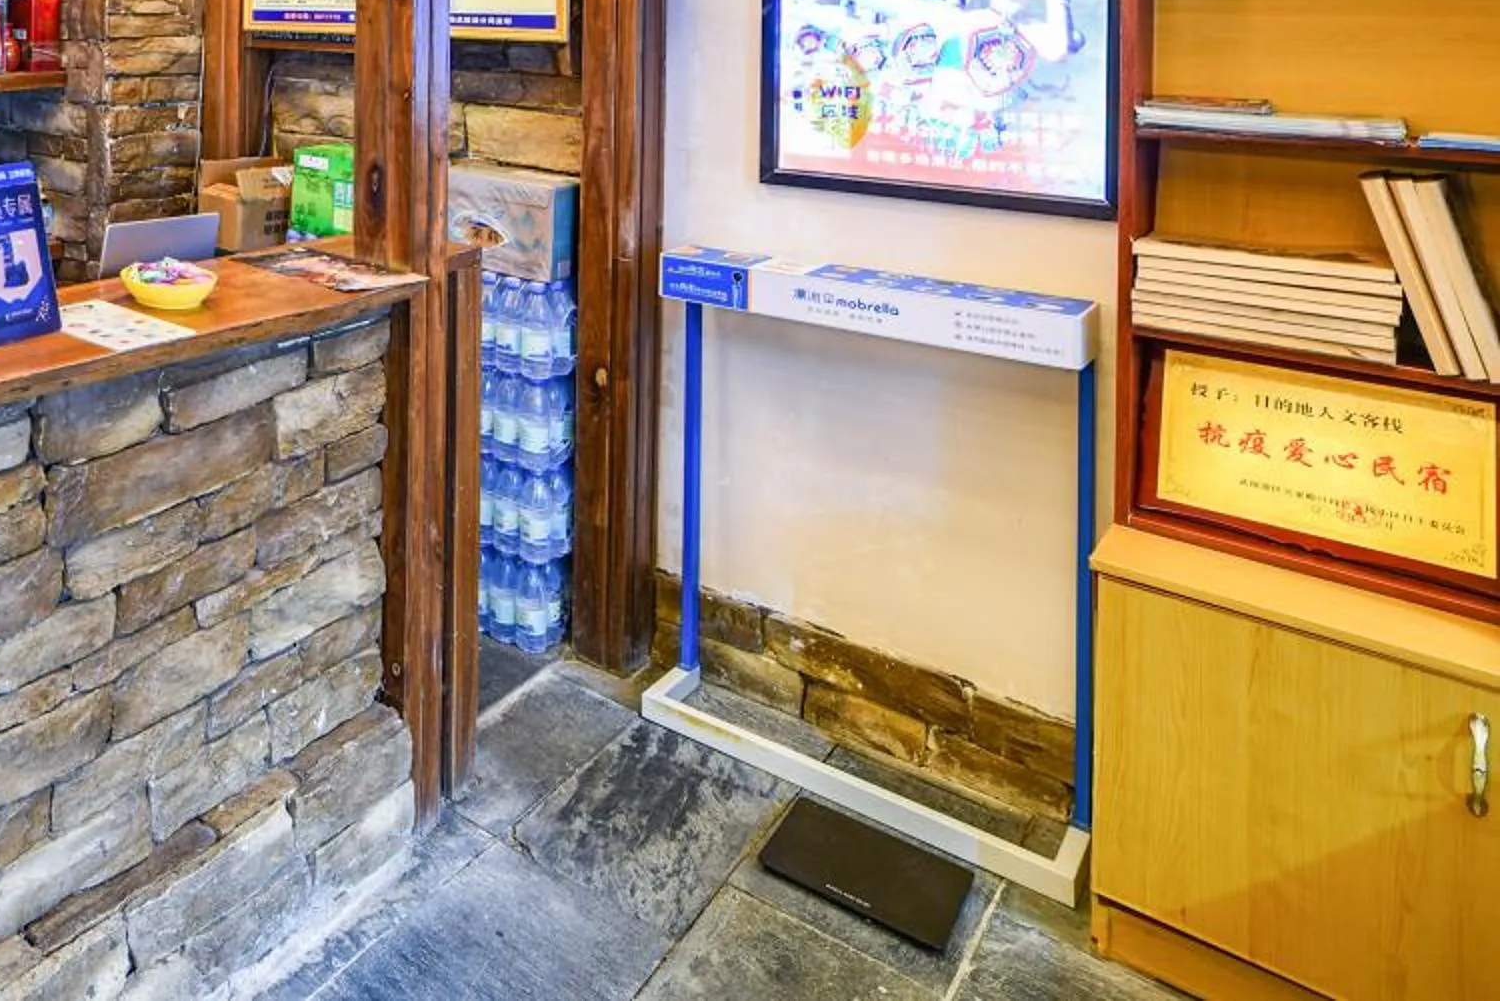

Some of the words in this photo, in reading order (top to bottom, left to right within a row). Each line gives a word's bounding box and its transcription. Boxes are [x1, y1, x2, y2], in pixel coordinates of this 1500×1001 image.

[836, 298, 899, 316] mobrella
[1198, 421, 1452, 495] 抗疫爱心民宿
